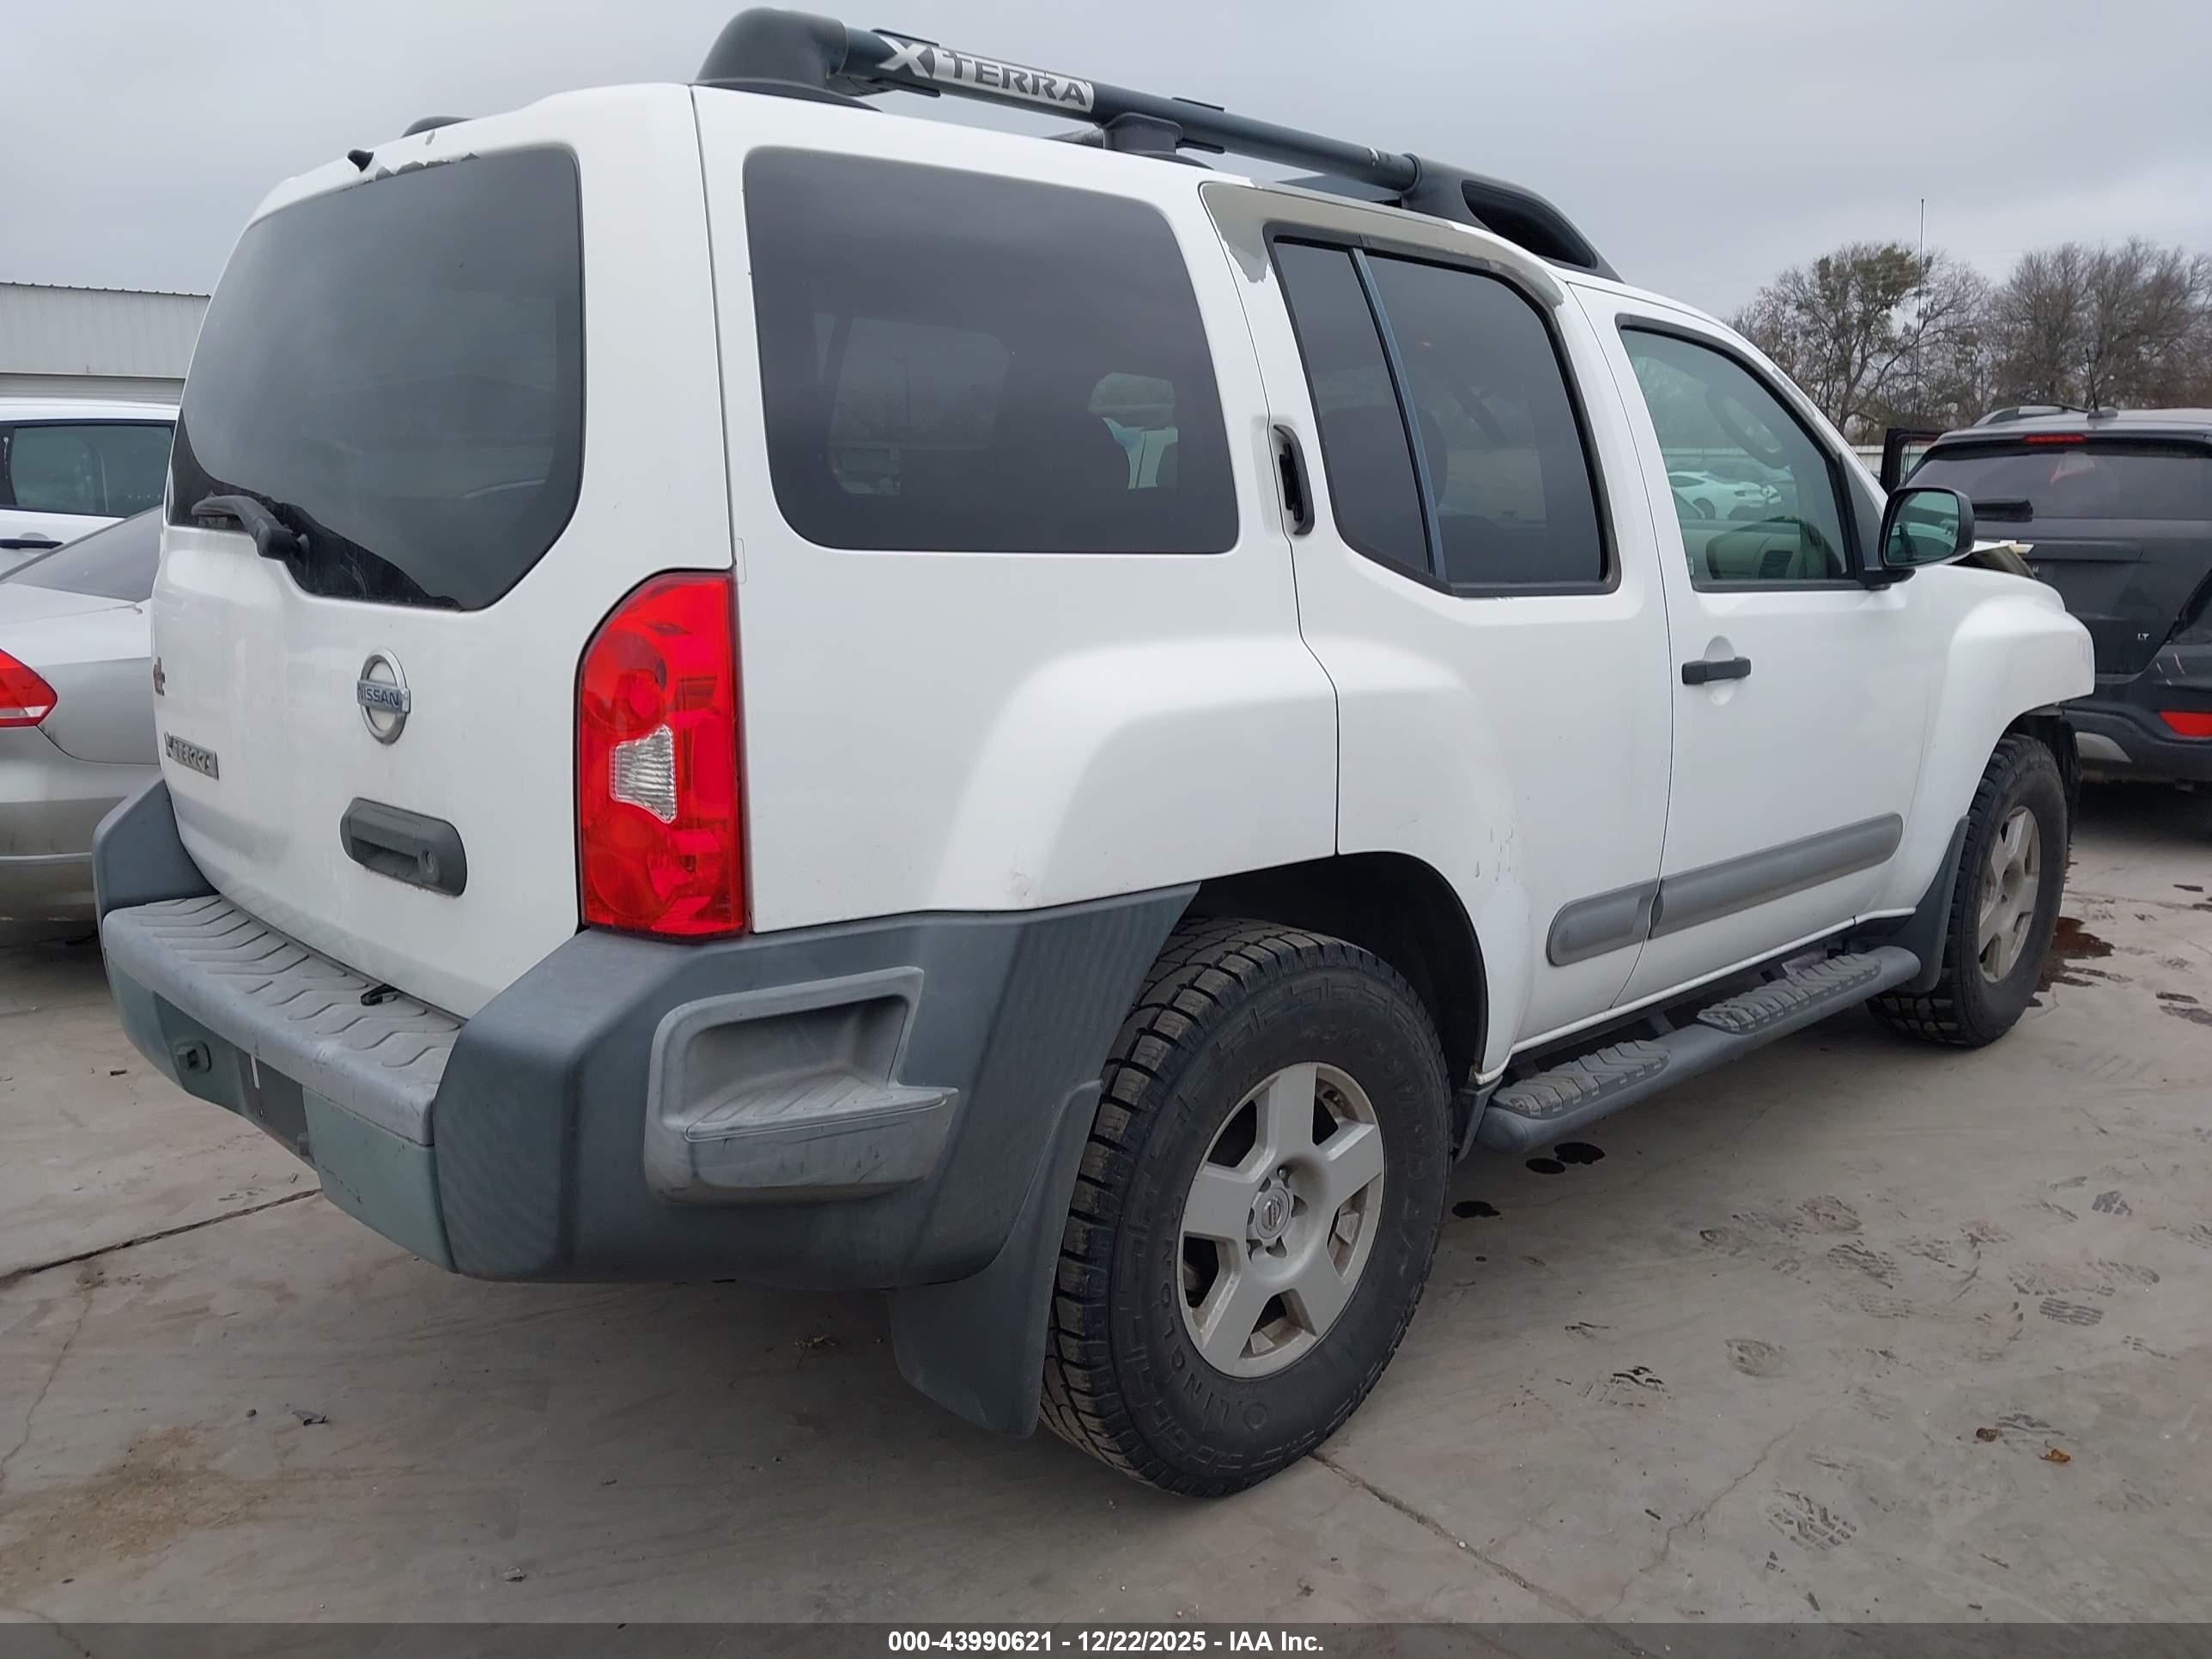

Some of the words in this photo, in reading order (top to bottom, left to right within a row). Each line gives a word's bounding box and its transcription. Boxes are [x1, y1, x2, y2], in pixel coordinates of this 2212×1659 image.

[877, 35, 1089, 108] XTERRA
[2137, 632, 2150, 641] LT
[357, 686, 399, 706] NISSAN
